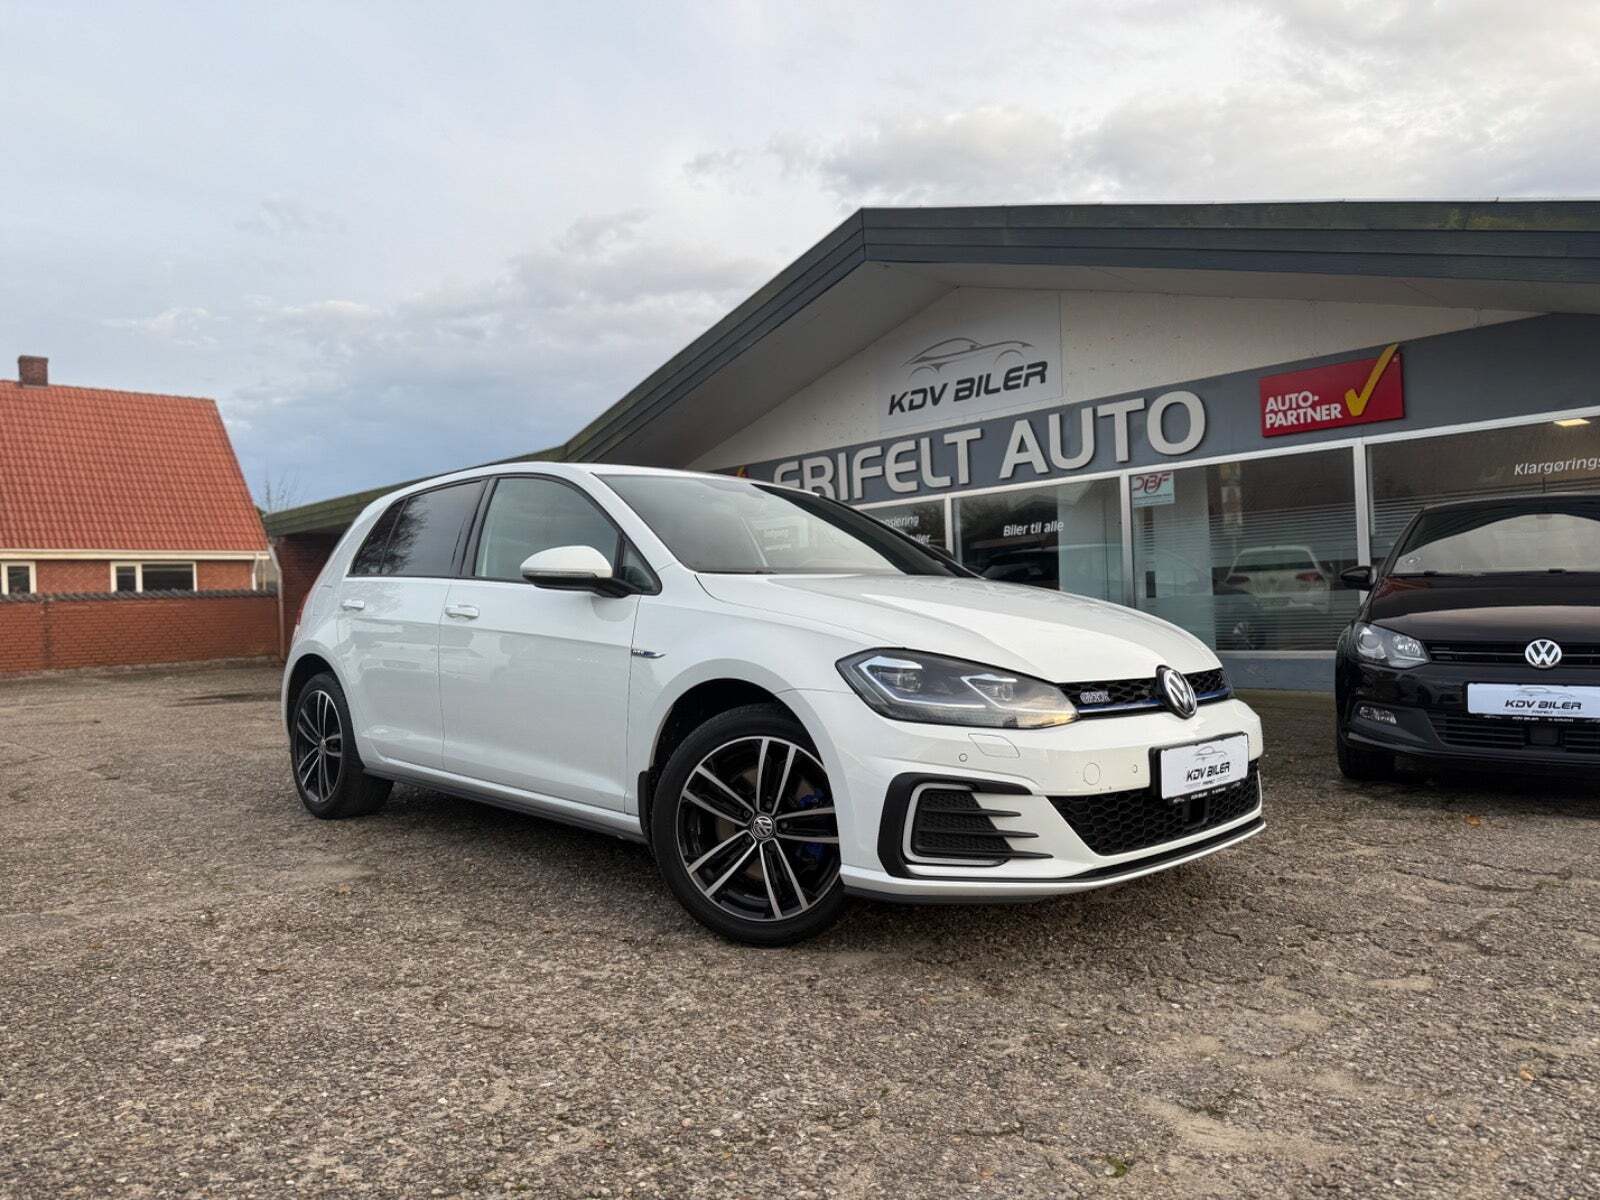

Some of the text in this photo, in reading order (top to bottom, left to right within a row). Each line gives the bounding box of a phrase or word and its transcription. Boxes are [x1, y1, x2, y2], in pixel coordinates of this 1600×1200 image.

[887, 360, 1049, 416] KDV BILER
[1265, 403, 1343, 429] PARTNER
[999, 390, 1206, 479] AUTO
[1003, 520, 1065, 537] Biler til alle
[1505, 699, 1582, 710] KDV BILER
[1186, 767, 1207, 781] KDV
[1207, 761, 1231, 777] BILER
